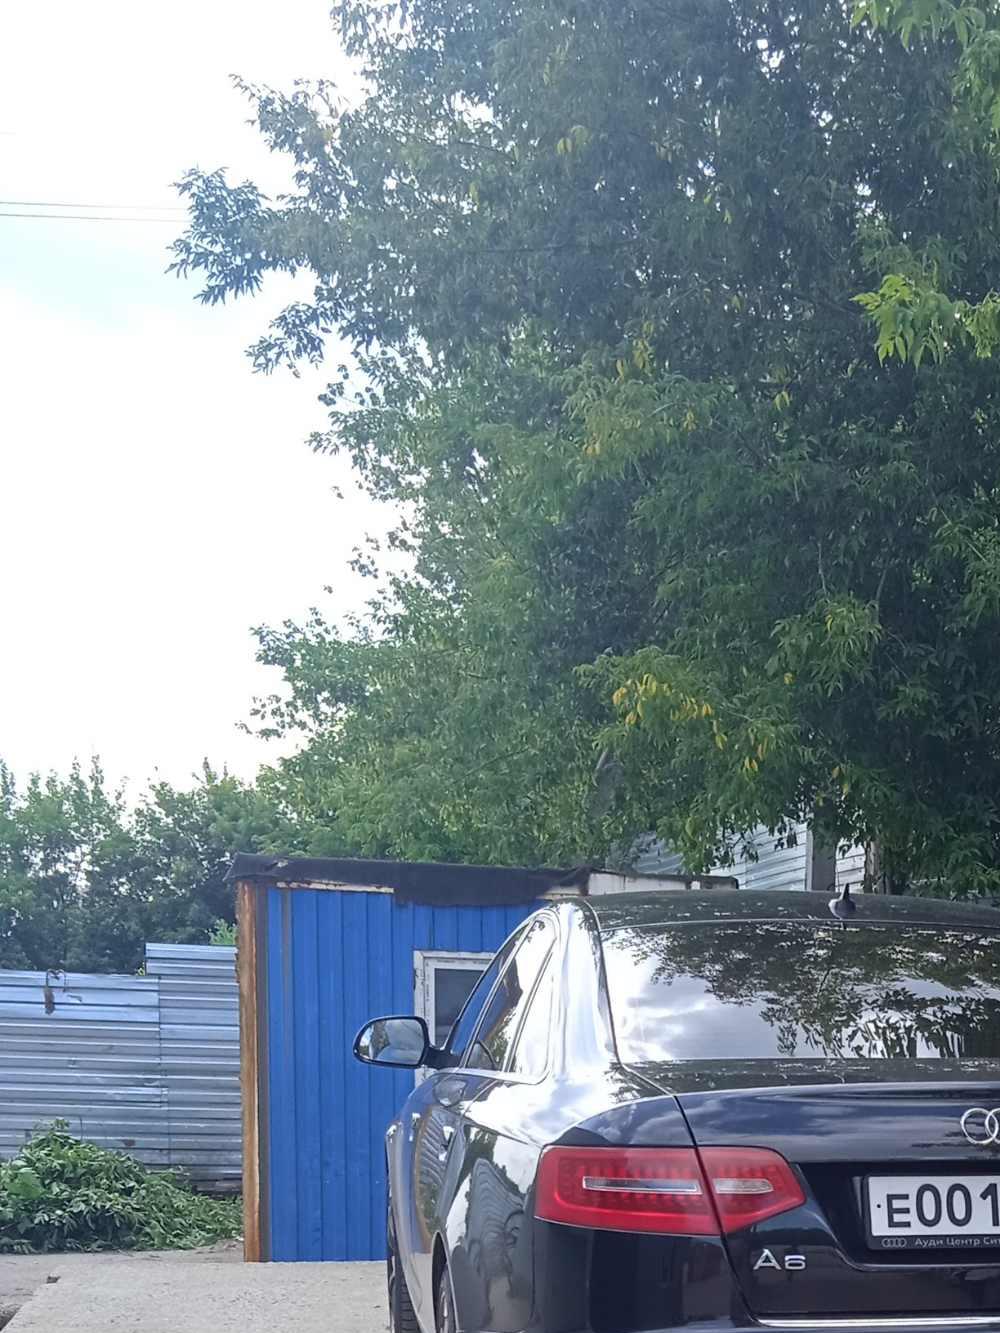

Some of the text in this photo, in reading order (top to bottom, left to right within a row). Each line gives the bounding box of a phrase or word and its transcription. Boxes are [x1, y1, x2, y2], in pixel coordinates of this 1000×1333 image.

[914, 1237, 944, 1248] Ауди
[946, 1237, 980, 1247] Центр
[753, 1248, 806, 1270] A6
